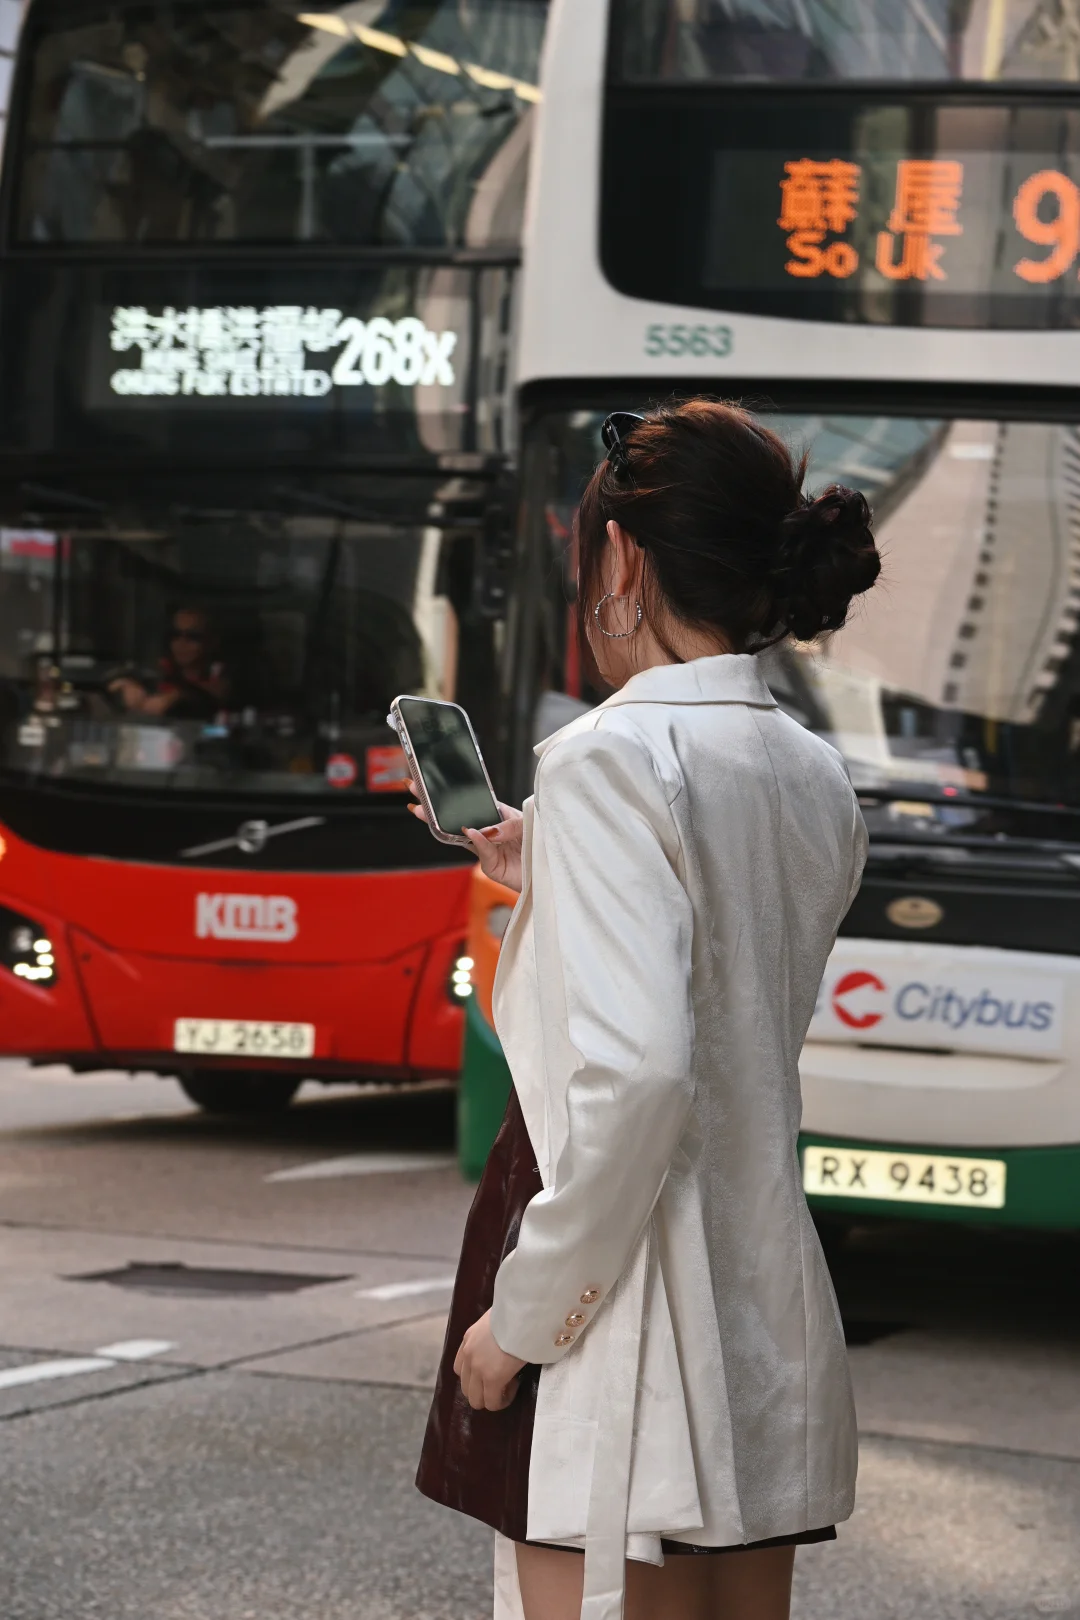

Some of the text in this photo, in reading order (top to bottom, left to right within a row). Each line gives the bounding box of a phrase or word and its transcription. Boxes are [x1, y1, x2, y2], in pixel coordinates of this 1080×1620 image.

[1012, 169, 1080, 284] 9
[784, 229, 947, 280] So Uk
[644, 324, 733, 358] 5563
[894, 981, 1054, 1032] Citybus
[186, 1023, 221, 1048] YJ
[819, 1154, 990, 1200] RX 9438
